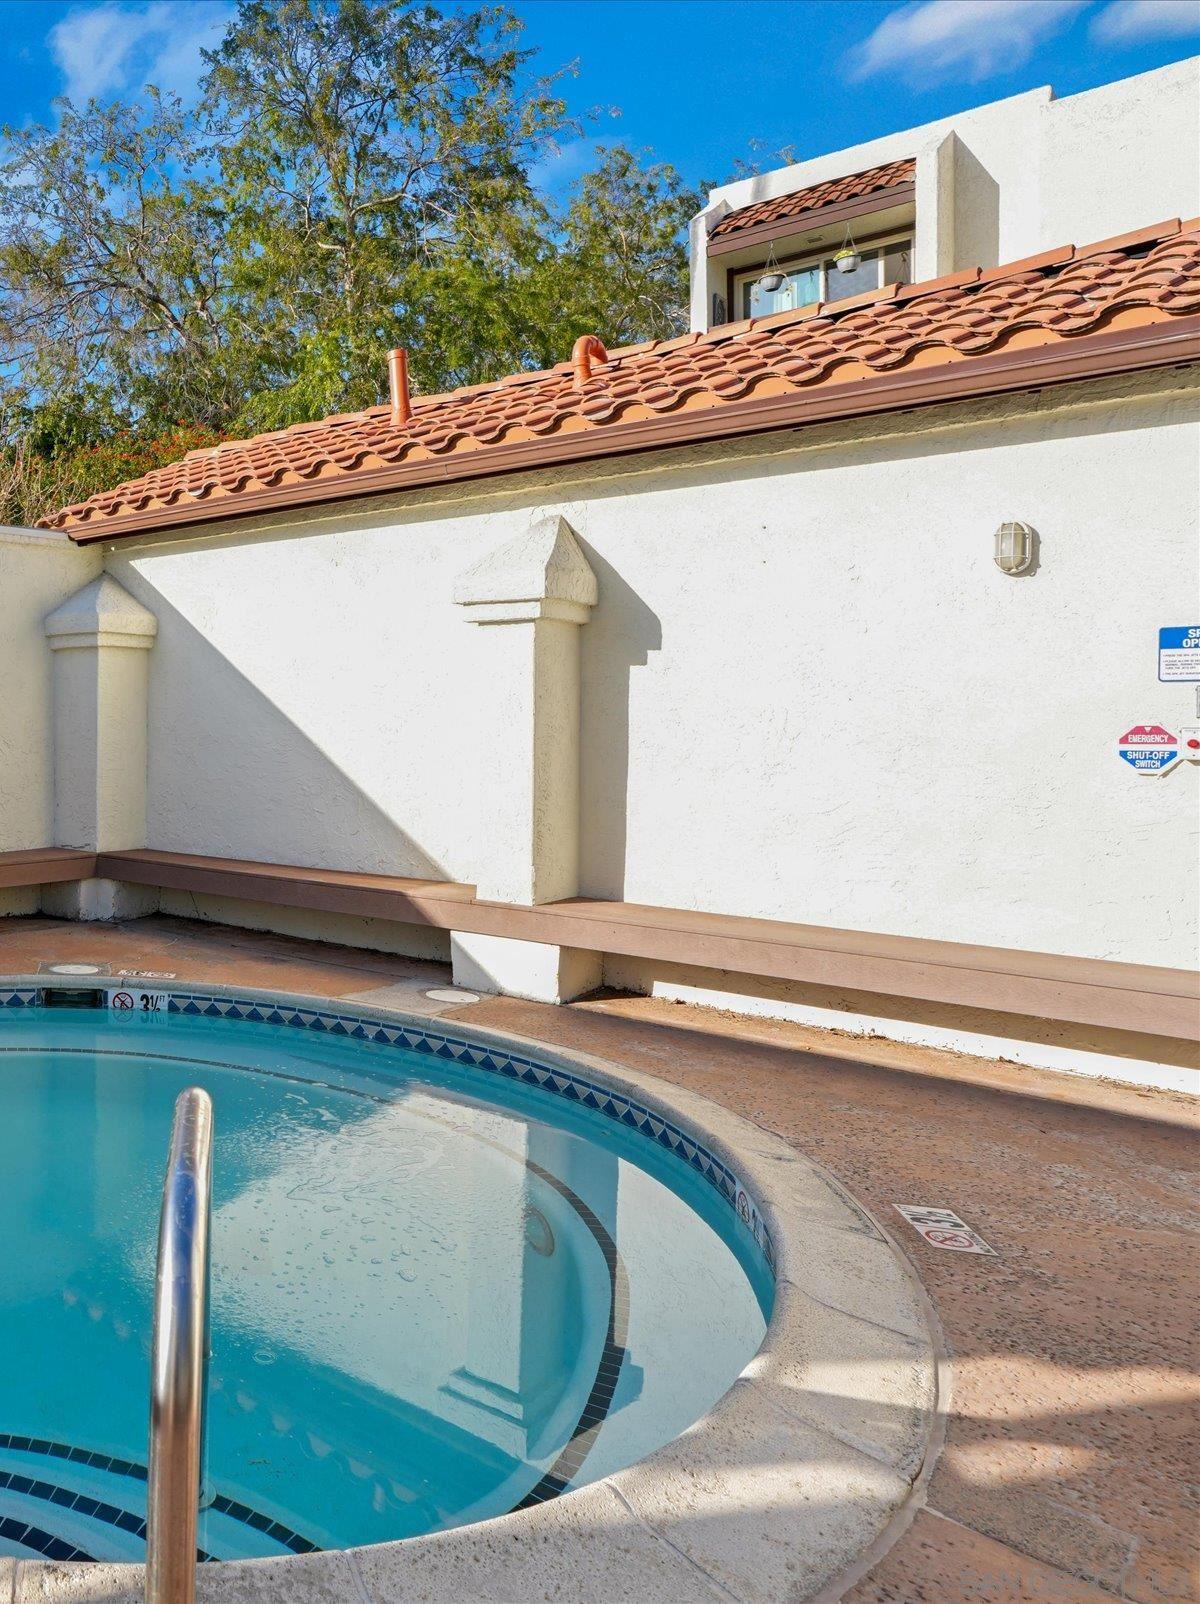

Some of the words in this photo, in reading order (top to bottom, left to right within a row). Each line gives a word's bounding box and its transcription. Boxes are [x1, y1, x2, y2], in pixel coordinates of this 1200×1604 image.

[1182, 638, 1200, 648] OP
[1128, 734, 1169, 743] EMERGENCY
[1127, 751, 1170, 760] SHUT-OFF
[1135, 760, 1161, 768] SWITCH
